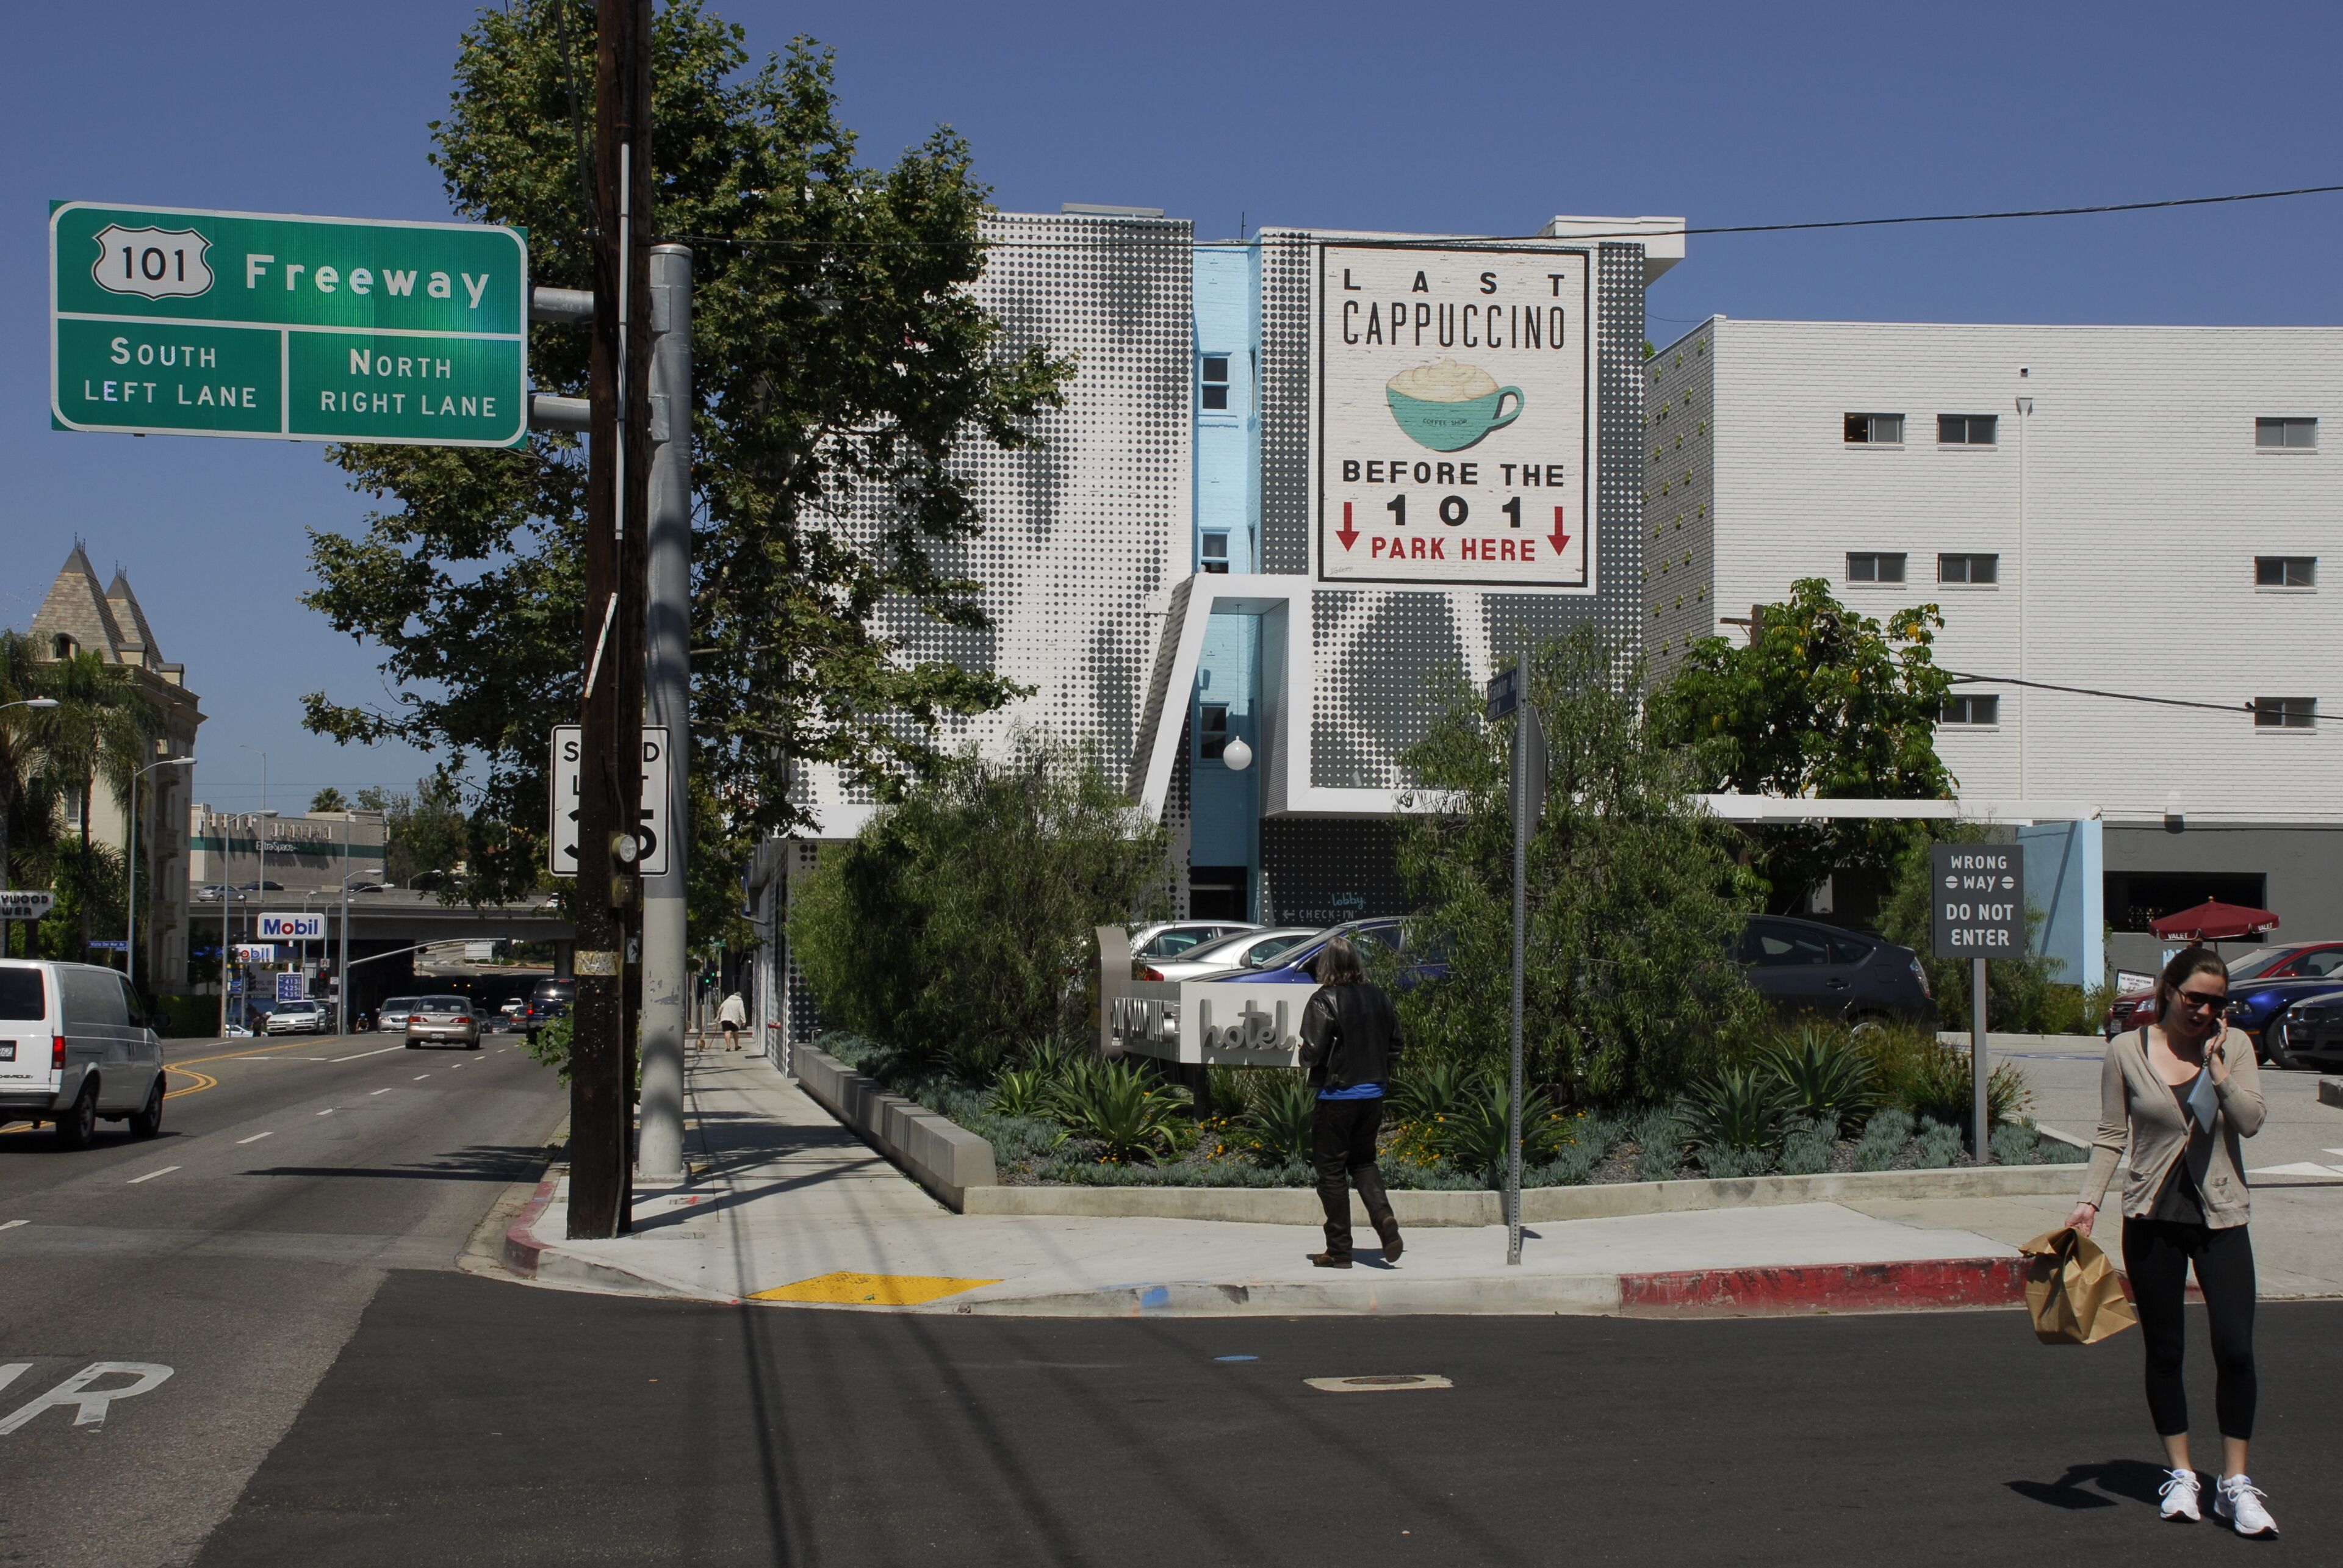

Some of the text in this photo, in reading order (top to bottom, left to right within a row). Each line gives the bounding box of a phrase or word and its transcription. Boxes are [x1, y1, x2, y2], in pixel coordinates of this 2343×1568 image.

[122, 246, 186, 282] 101
[246, 254, 490, 309] Freeway
[1344, 268, 1564, 297] LAST
[1343, 300, 1564, 350] CAPPUCCINO
[85, 380, 256, 408] LEFT LANE
[321, 391, 496, 417] RIGHT LANE
[1343, 459, 1564, 487] BEFORE THE
[1386, 494, 1521, 528] 101
[1372, 536, 1536, 561] PARK HERE
[256, 841, 293, 852] EtraSpace
[1951, 855, 2007, 869] WRONG
[1963, 876, 1996, 892] WAY
[1331, 892, 1365, 910] lobby
[1299, 910, 1355, 919] CHECK-IN
[1946, 904, 2014, 921] DO NOT
[264, 919, 318, 935] Mobil
[2258, 922, 2273, 931] VALET
[1951, 929, 2010, 946] ENTER
[240, 948, 269, 958] obil
[1200, 999, 1297, 1049] hotel
